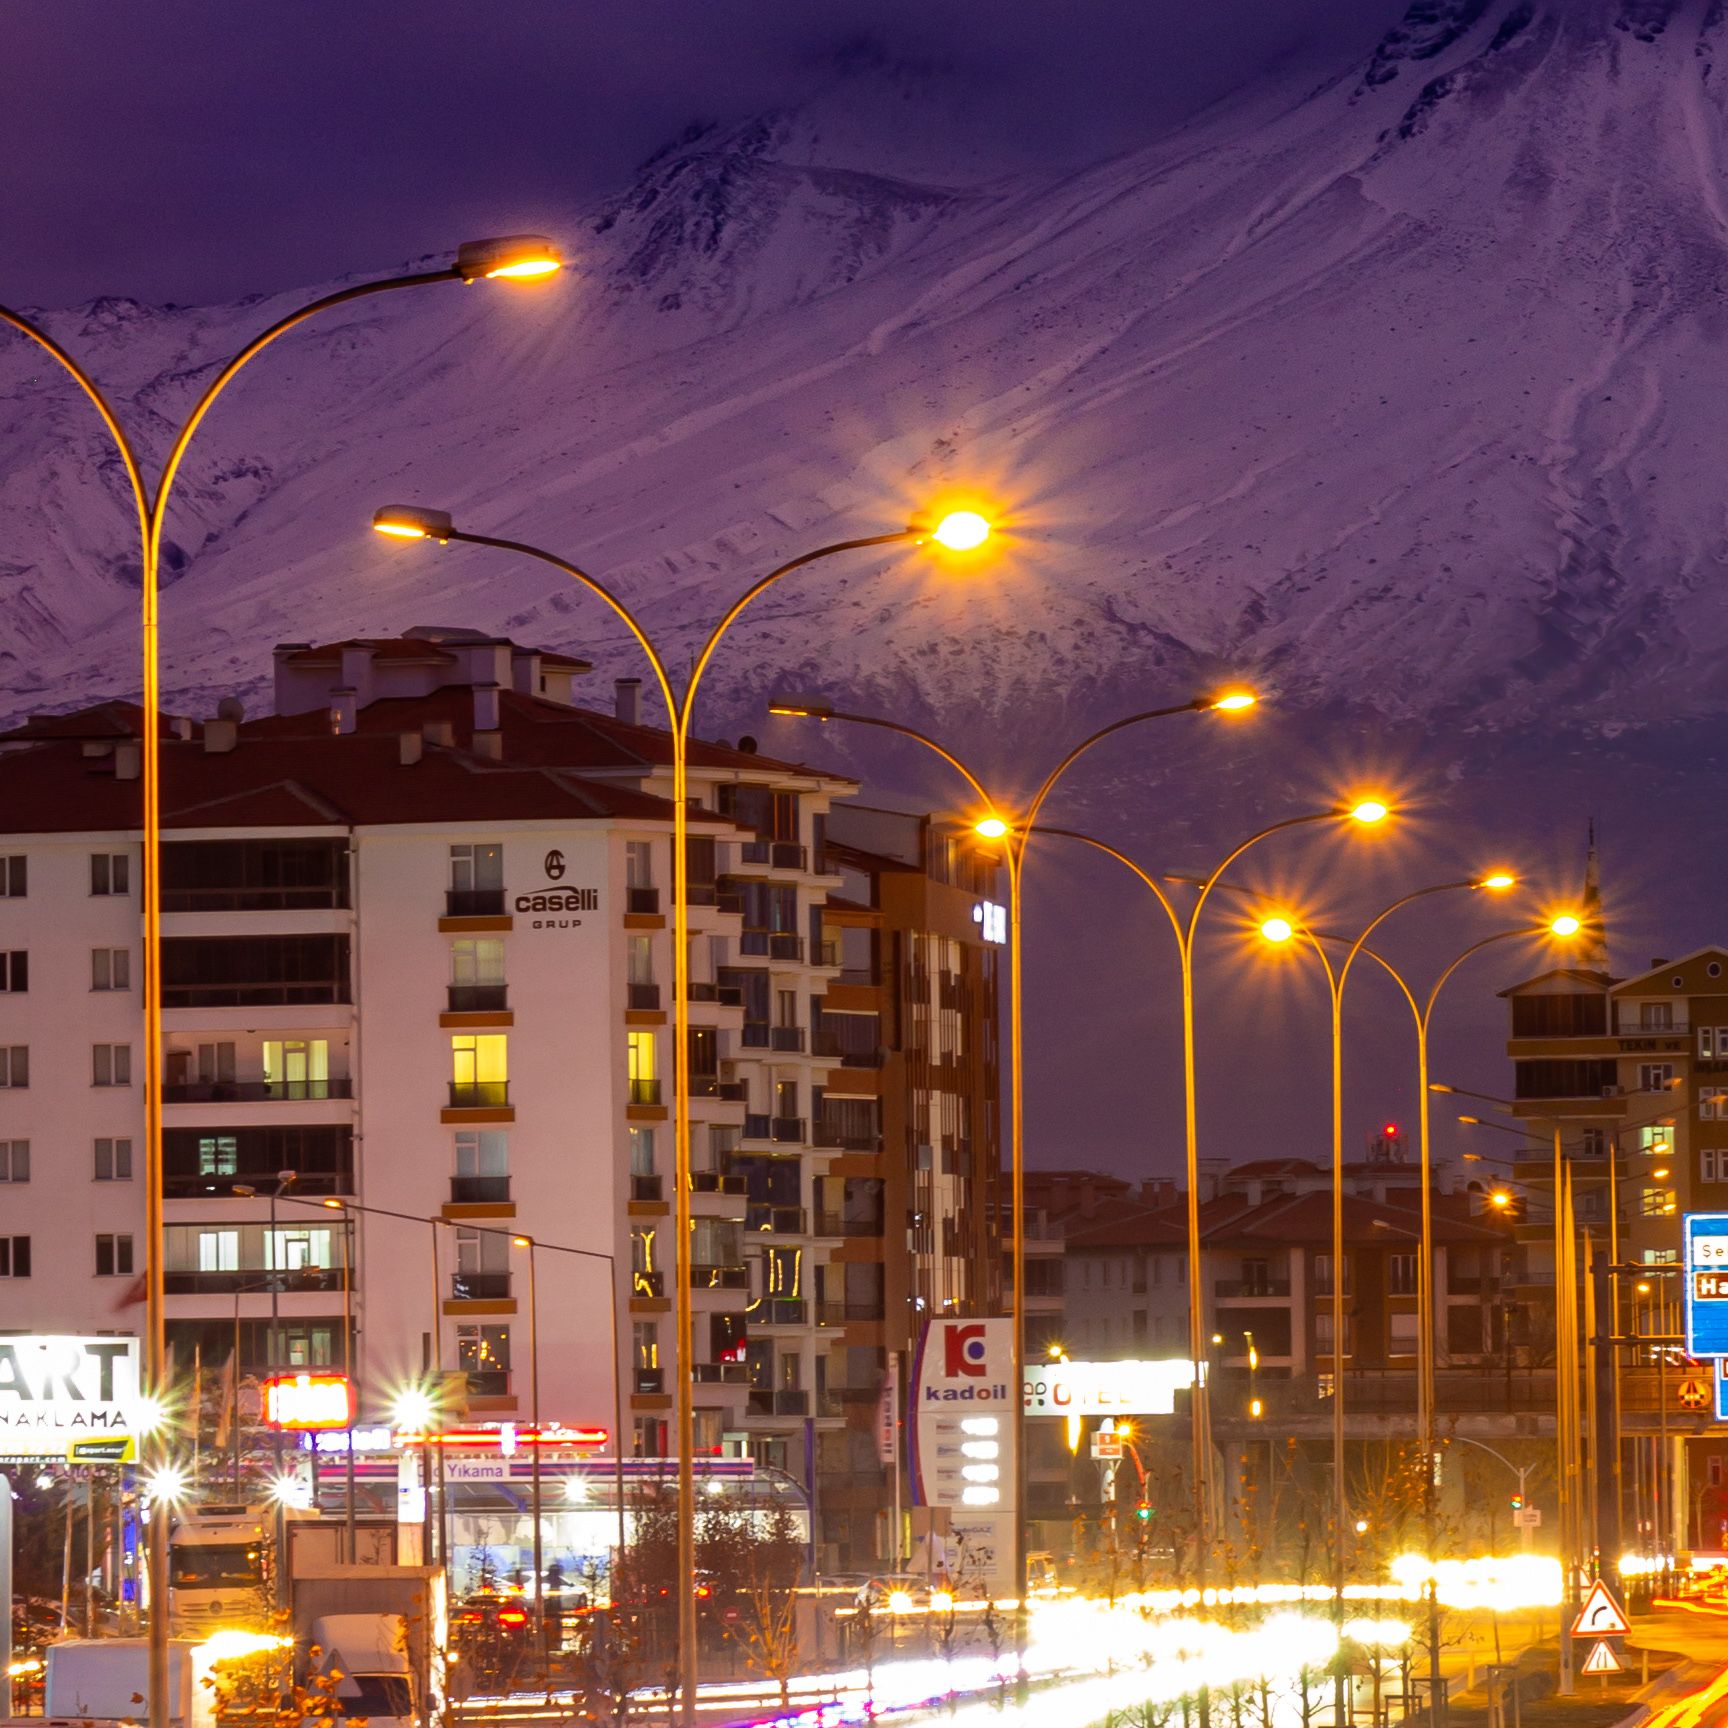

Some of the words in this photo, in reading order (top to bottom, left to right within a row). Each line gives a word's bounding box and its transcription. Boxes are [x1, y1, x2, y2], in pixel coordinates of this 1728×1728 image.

[514, 888, 599, 913] caselli
[532, 919, 582, 929] GRUP
[925, 1384, 1007, 1402] kadoil
[447, 1464, 504, 1477] Yıkama
